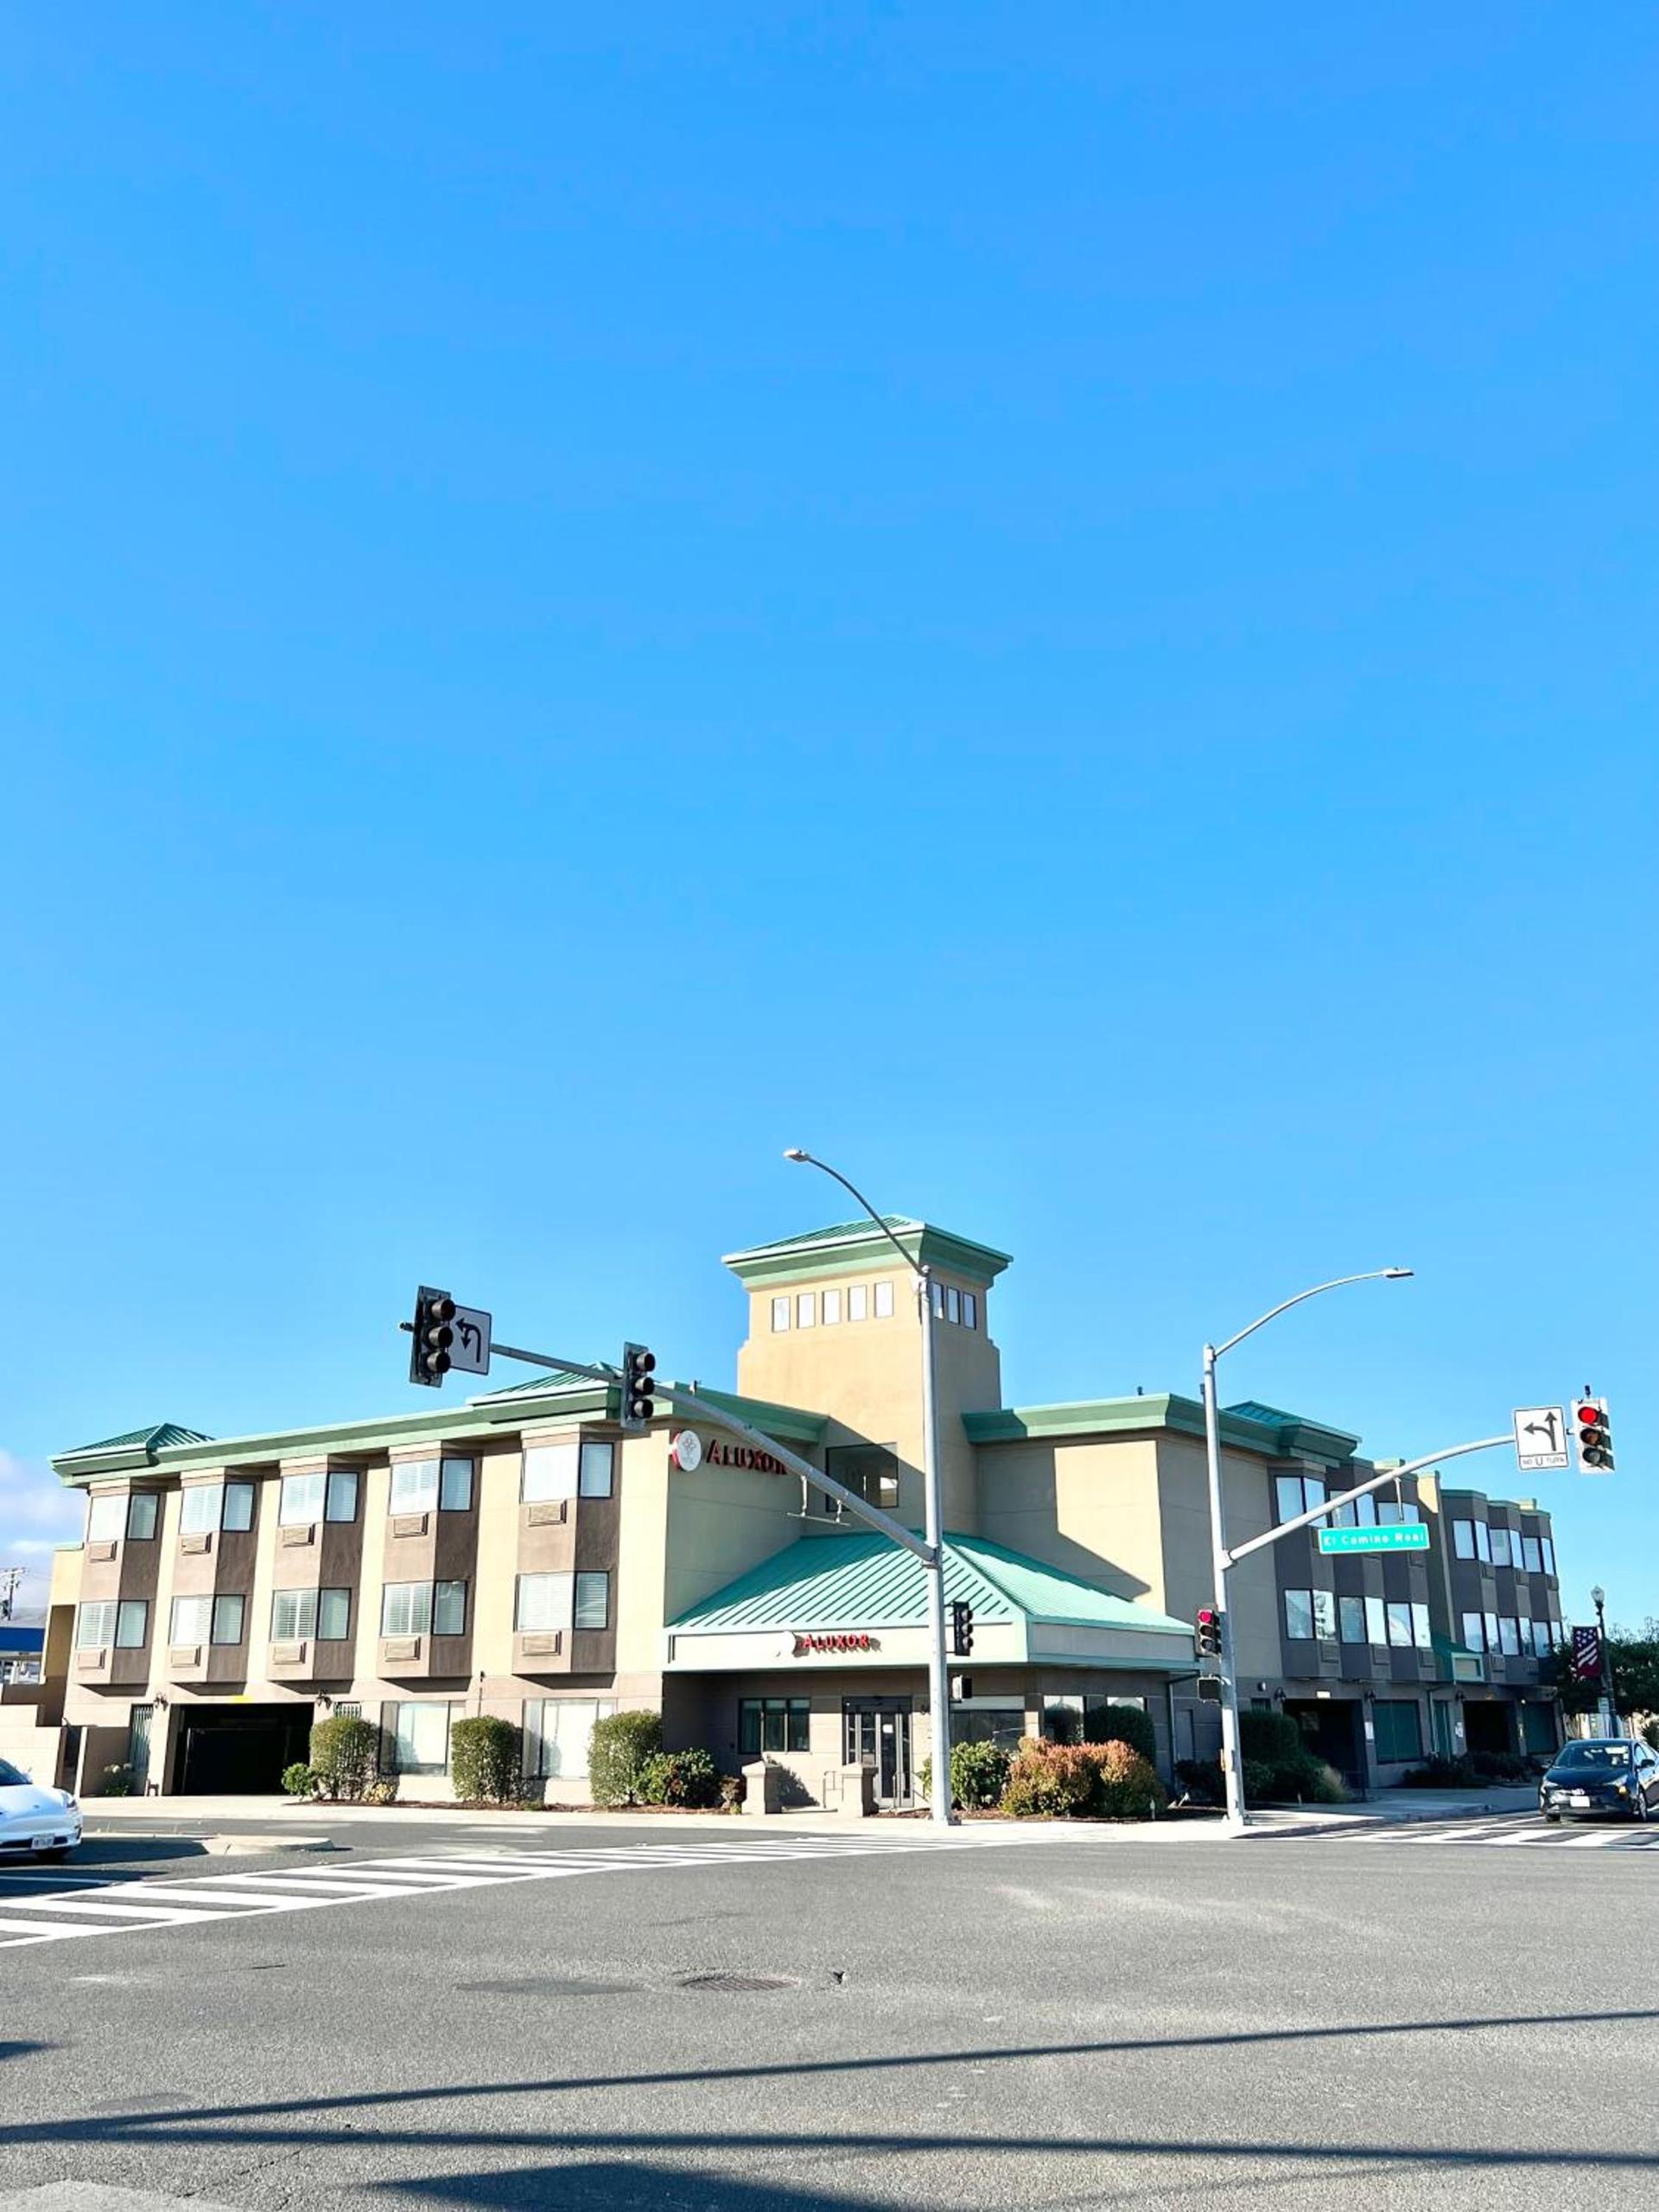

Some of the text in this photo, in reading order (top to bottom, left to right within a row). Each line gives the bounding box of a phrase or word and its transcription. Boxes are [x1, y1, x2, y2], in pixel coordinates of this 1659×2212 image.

[1535, 1456, 1543, 1466] U
[1324, 1532, 1424, 1546] El Camino Real
[802, 1633, 869, 1649] ALUXOR
